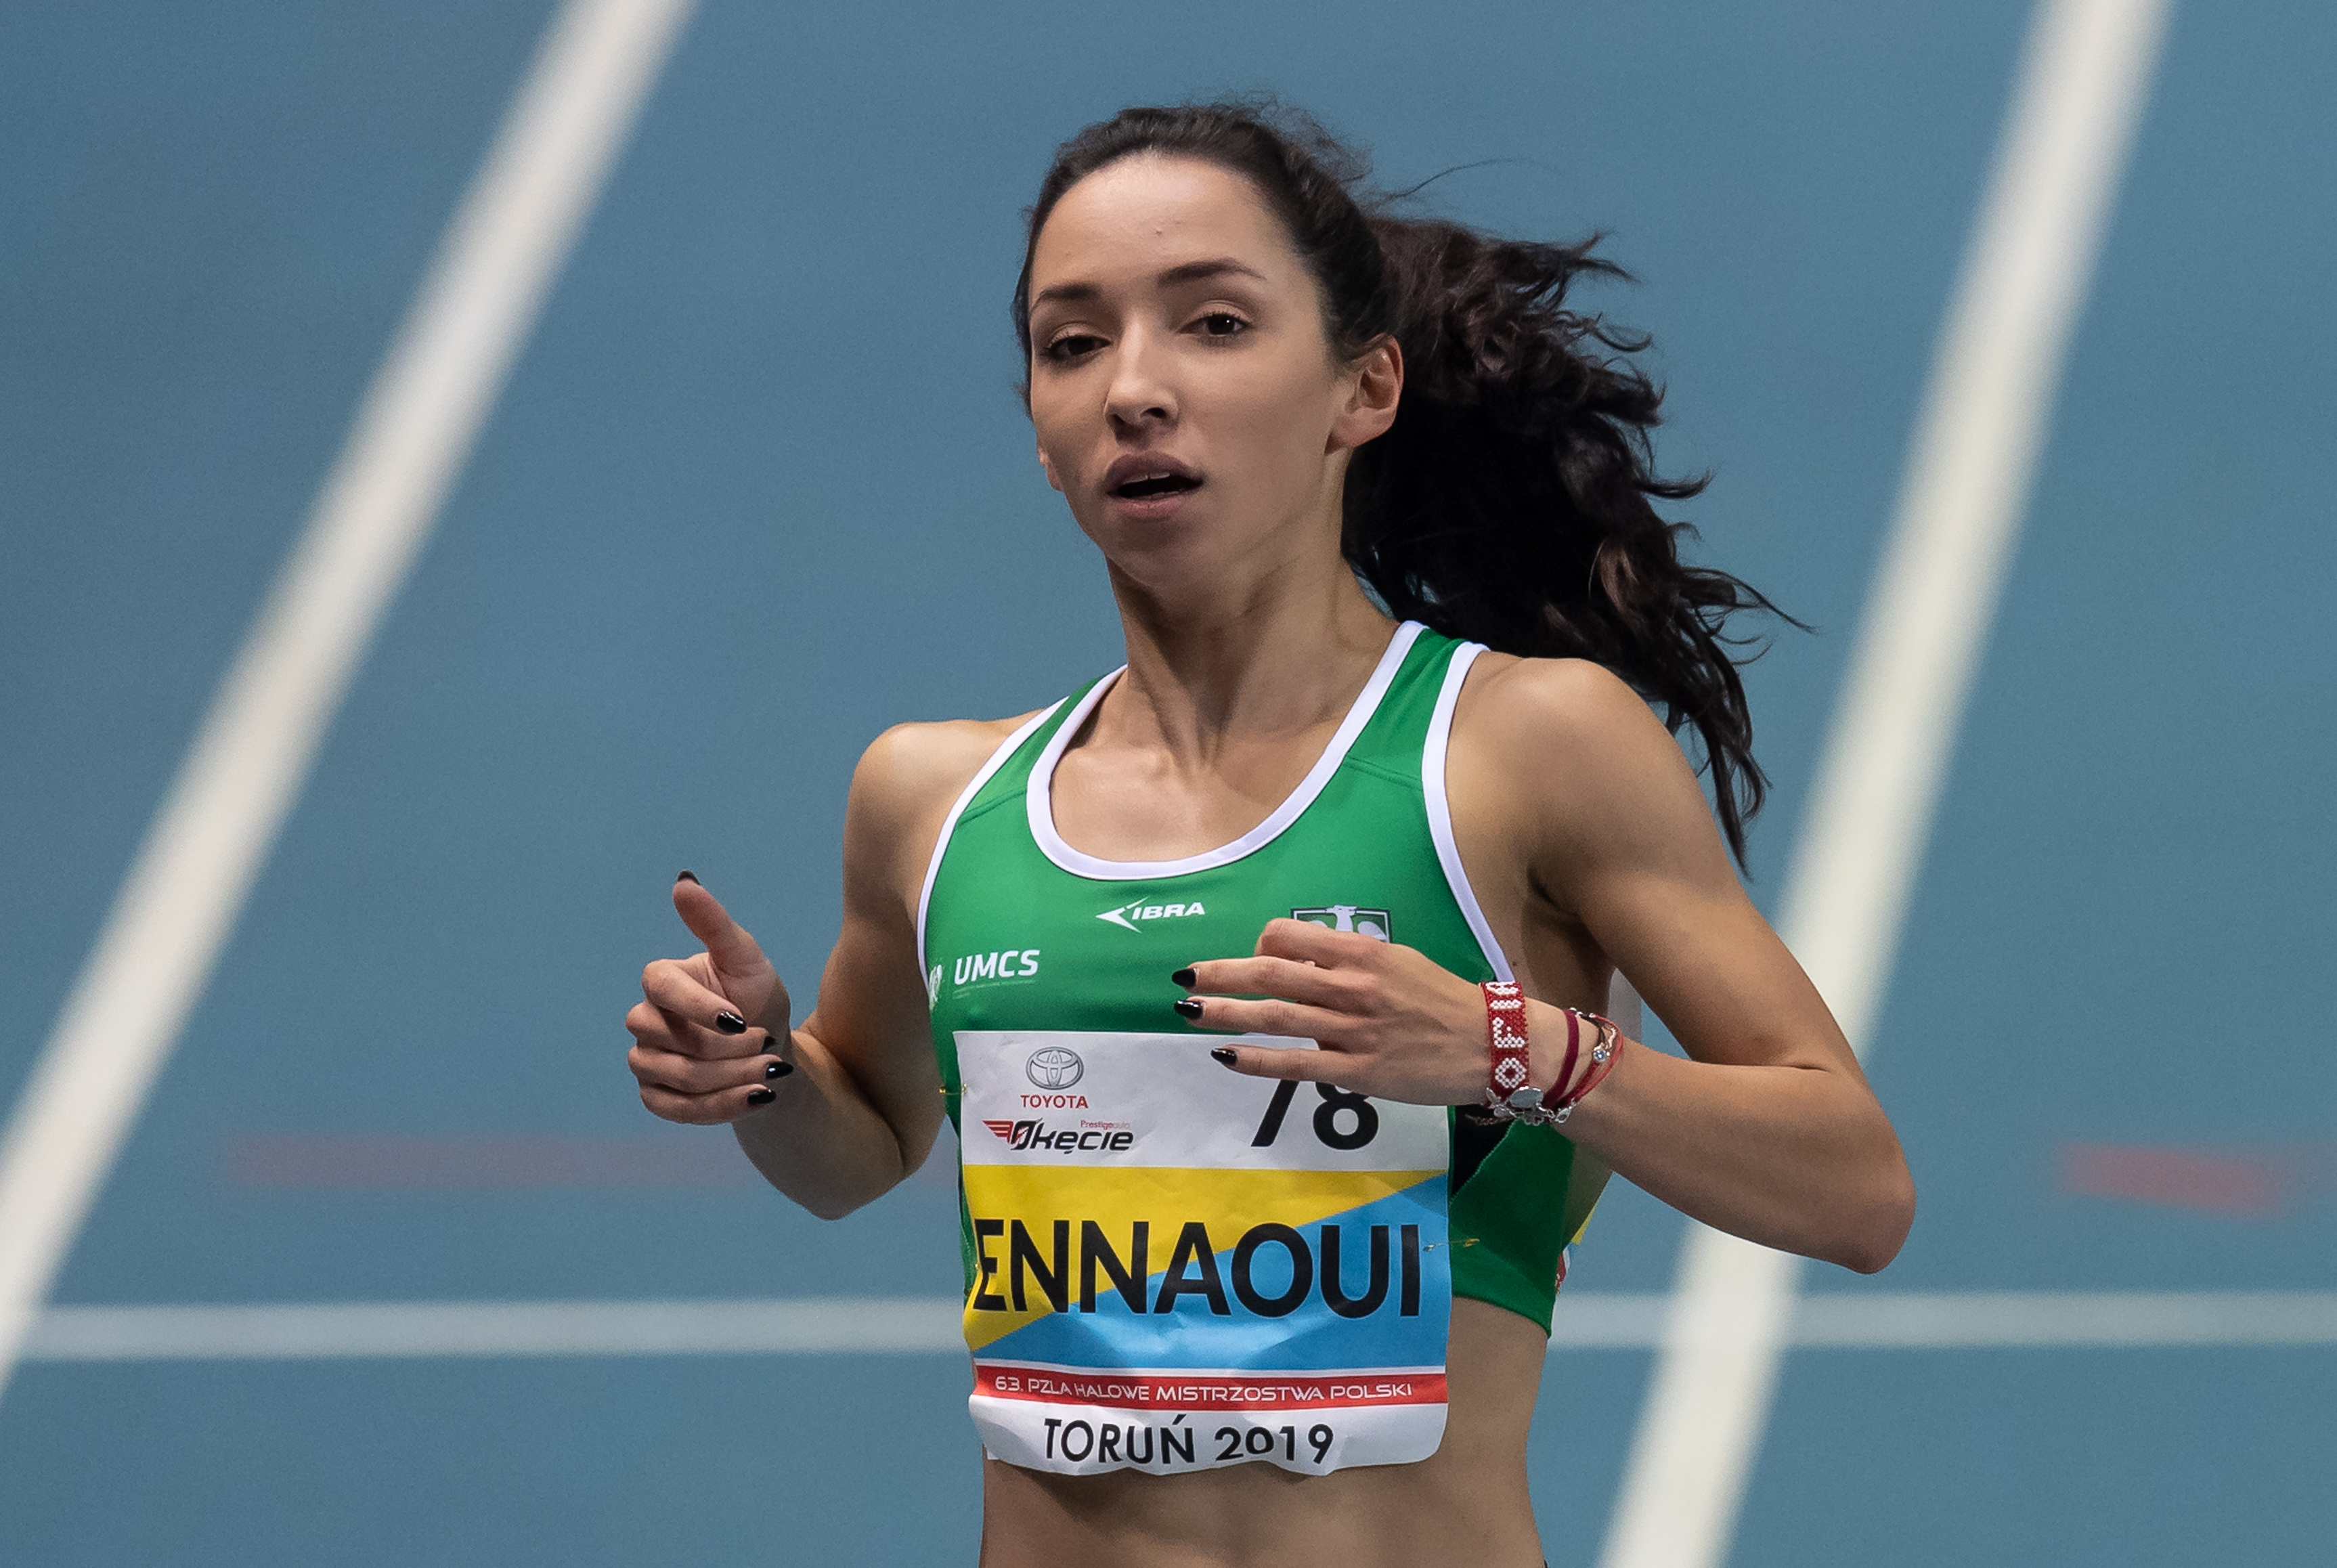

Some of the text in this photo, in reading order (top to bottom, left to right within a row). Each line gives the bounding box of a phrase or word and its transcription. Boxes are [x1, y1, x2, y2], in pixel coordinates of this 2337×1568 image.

[1132, 902, 1205, 919] IBRA
[955, 950, 1041, 985] UMCS
[1020, 1095, 1089, 1108] TOYOTA
[1251, 1079, 1379, 1150] 78
[973, 1219, 1420, 1319] ENNAOUI
[995, 1376, 1412, 1401] 63. PZLA HALOWE MISTRZOSTWA POLSKI
[1044, 1414, 1334, 1464] TORUŃ 2019
